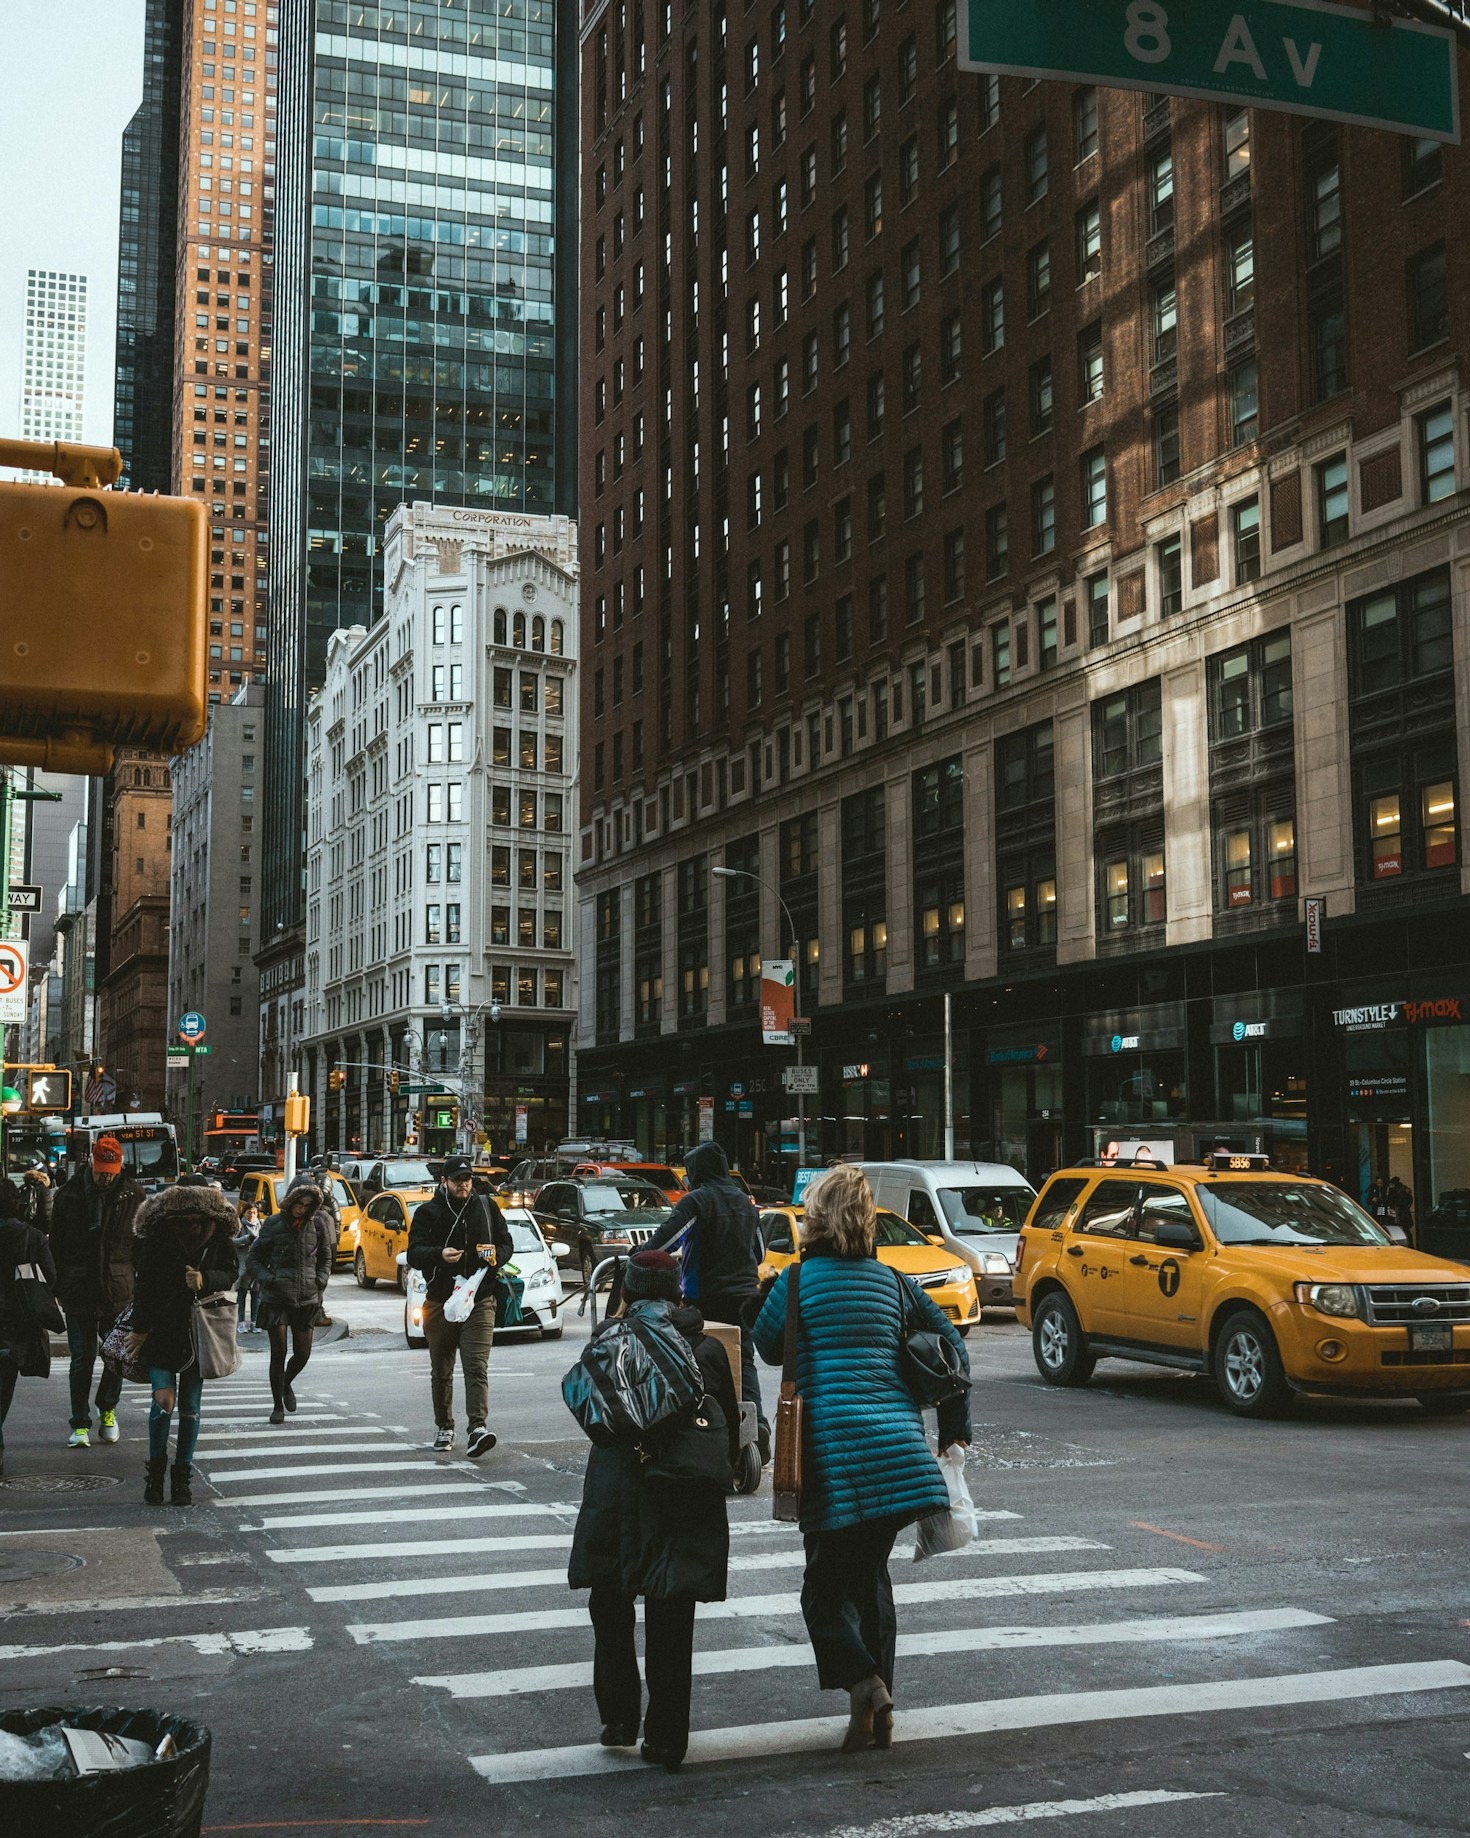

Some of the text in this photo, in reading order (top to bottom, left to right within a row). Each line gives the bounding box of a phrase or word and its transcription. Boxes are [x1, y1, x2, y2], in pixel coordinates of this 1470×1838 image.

[1124, 0, 1171, 64] 8
[453, 510, 531, 527] CORPORATION
[1332, 1004, 1389, 1026] TURNSTYLE
[1245, 1023, 1266, 1037] AT&T
[1121, 1036, 1139, 1049] AT&T
[146, 1129, 155, 1137] ST
[1229, 1157, 1251, 1169] 5B56
[1164, 1266, 1176, 1292] T
